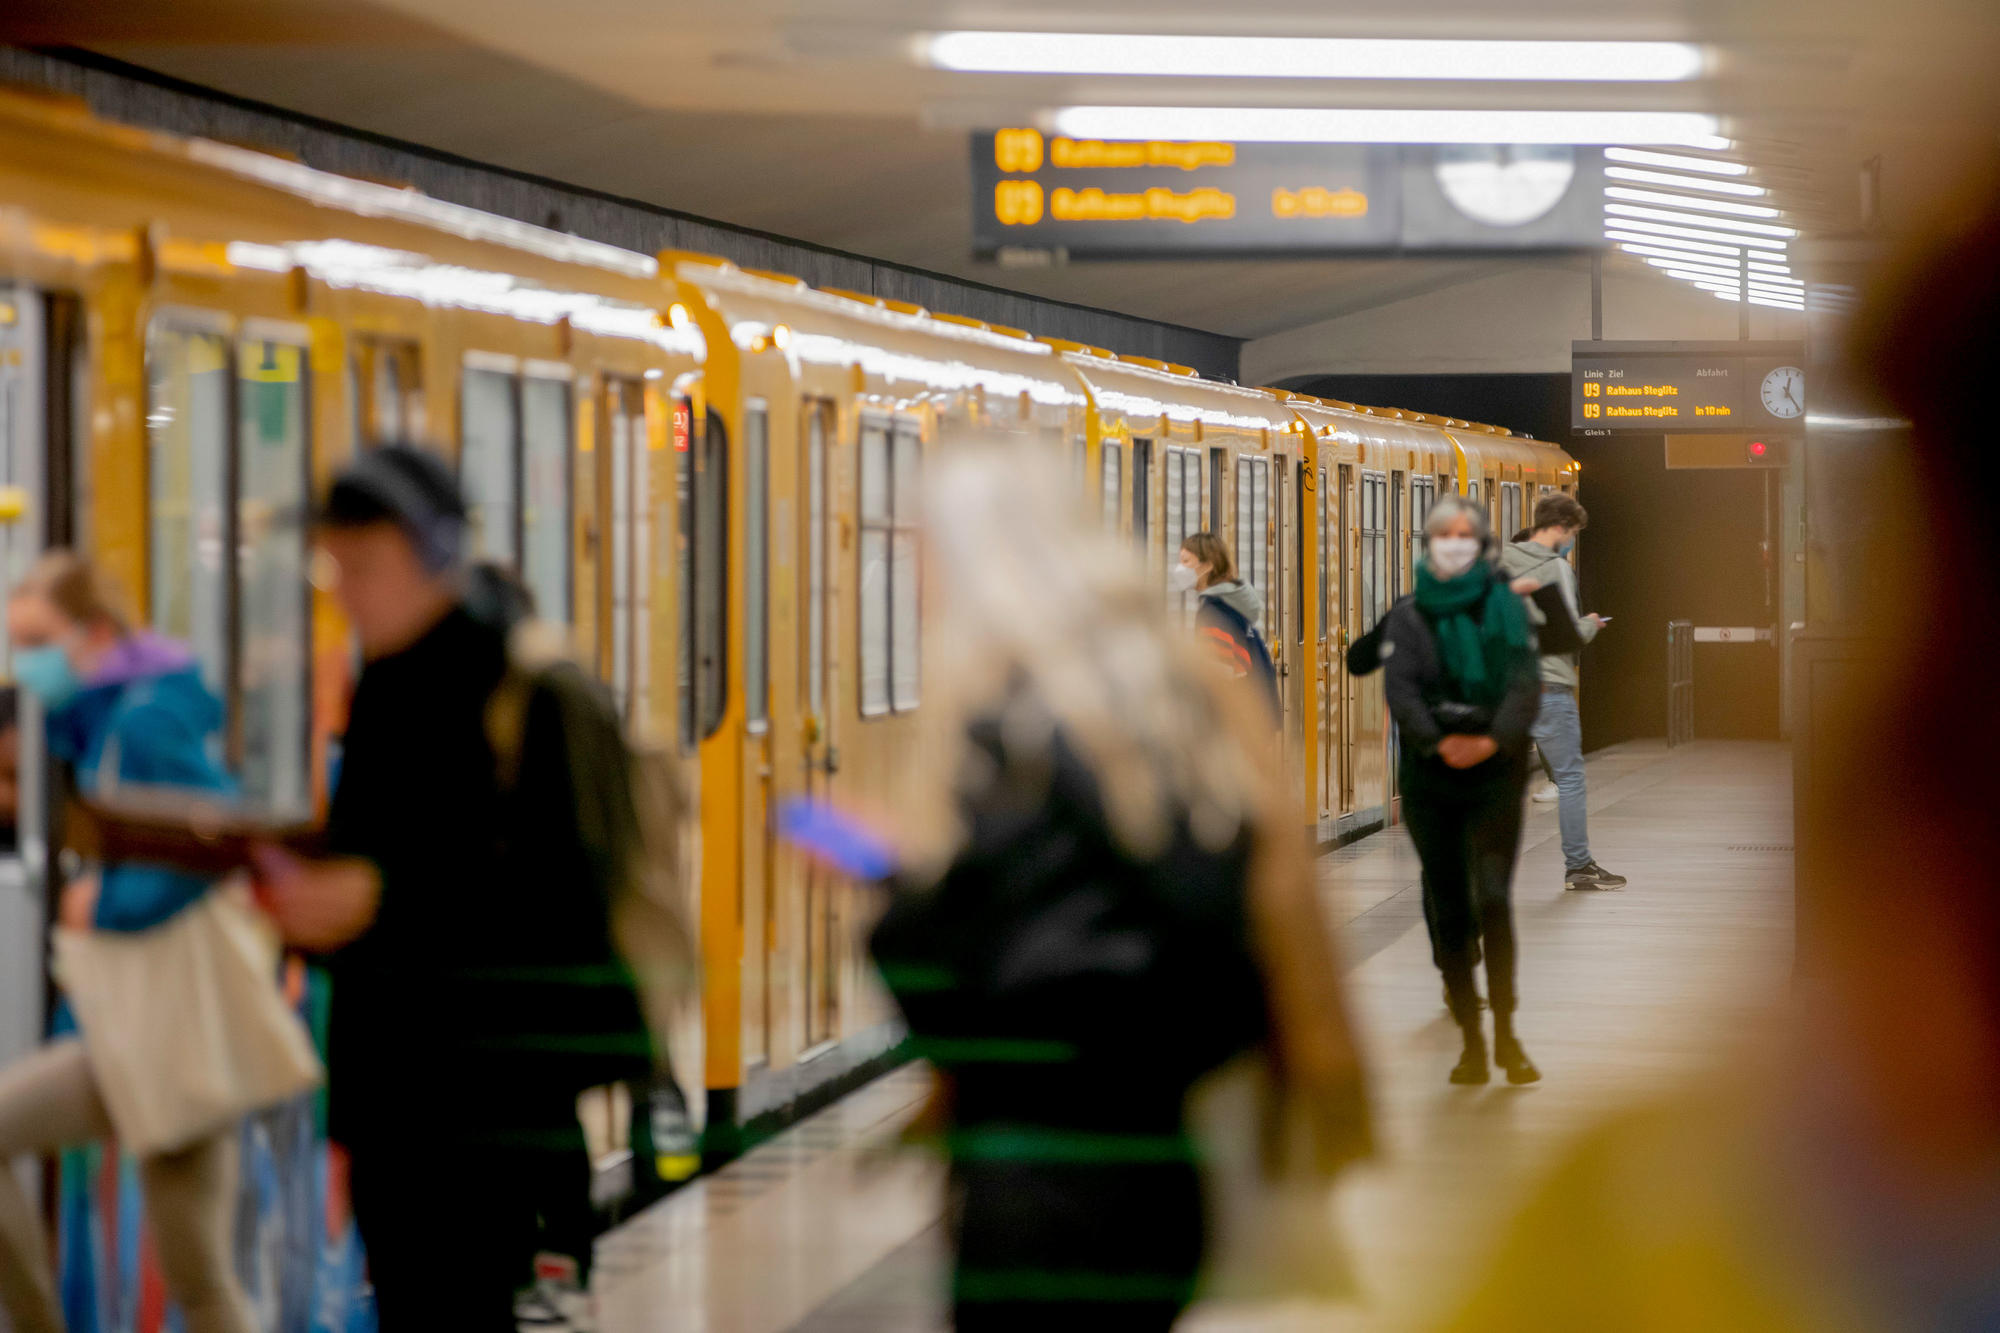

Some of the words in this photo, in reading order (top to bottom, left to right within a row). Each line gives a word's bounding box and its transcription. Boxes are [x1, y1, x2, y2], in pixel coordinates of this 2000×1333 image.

[1584, 370, 1604, 378] Linie
[1608, 370, 1624, 378] Ziel
[1696, 368, 1728, 377] Abfahrt
[1584, 382, 1600, 397] U9
[1606, 385, 1642, 395] Rathaus
[1643, 385, 1678, 397] Steglitz
[1584, 403, 1600, 418] U9
[1606, 406, 1642, 416] Rathaus
[1643, 406, 1678, 417] Steglitz
[1695, 406, 1705, 416] in
[1705, 406, 1716, 416] 10
[1716, 406, 1731, 416] min
